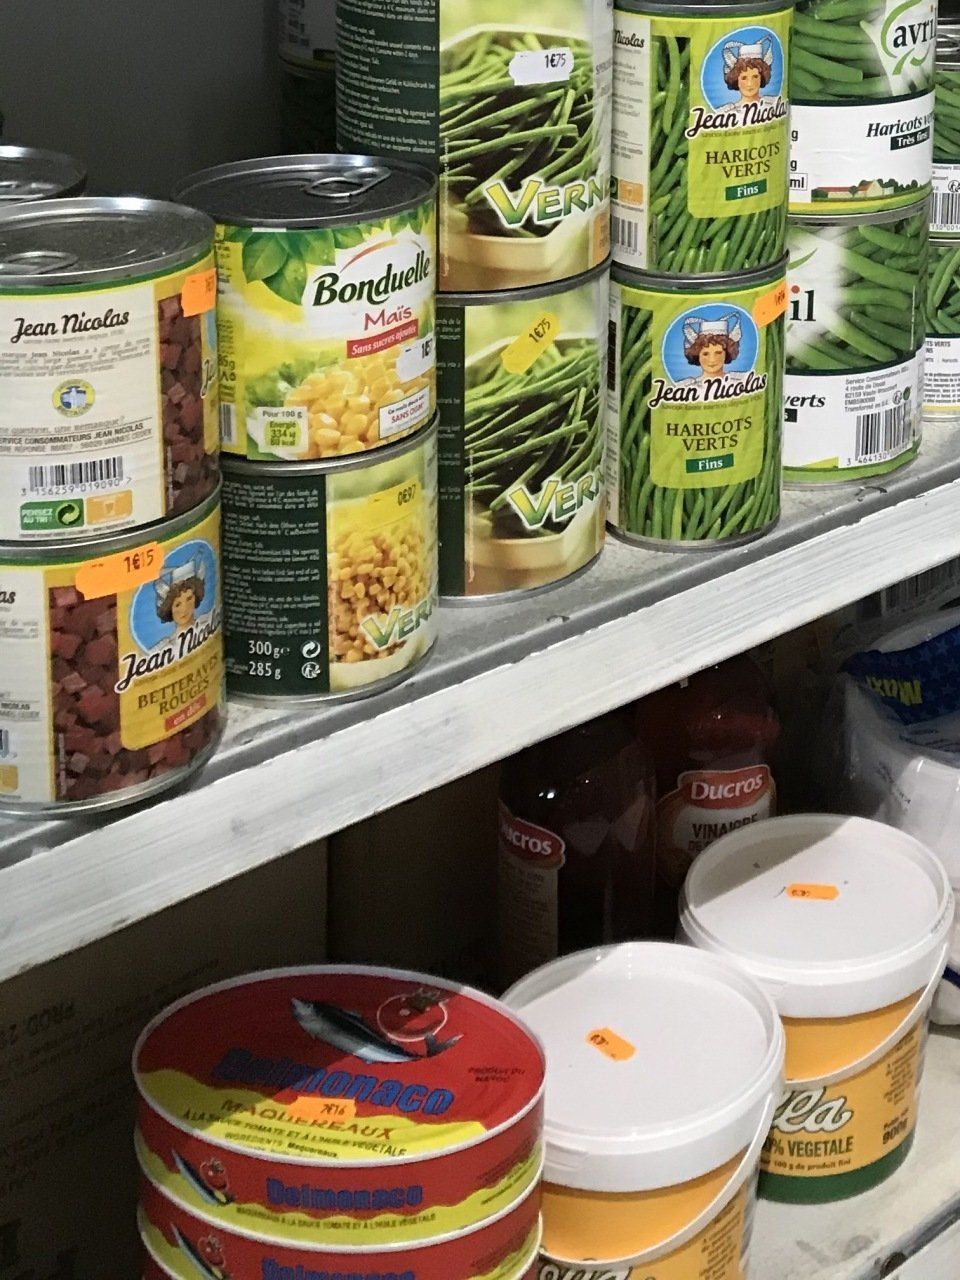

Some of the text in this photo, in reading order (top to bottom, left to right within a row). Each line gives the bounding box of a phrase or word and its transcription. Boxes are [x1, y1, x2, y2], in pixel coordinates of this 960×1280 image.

[544, 53, 568, 69] 1€75
[685, 107, 738, 139] Jean
[866, 116, 923, 139] Haricots
[705, 141, 781, 165] HARICOTS
[896, 135, 915, 148] Très
[722, 160, 771, 179] VERTS
[737, 185, 760, 198] Fins
[312, 250, 431, 307] Bonduelle
[10, 308, 131, 344] Jean Nicolas
[363, 304, 413, 331] Maïs
[528, 317, 552, 344] 1€75
[352, 341, 373, 356] Sans
[373, 335, 395, 352] sucres
[649, 370, 768, 408] Jean Nicolas
[390, 411, 410, 424] SANS
[665, 416, 753, 438] HARICOTS
[24, 422, 144, 446] CONSOMMATEURS JEAN NICOLAS
[270, 429, 287, 438] 334
[681, 433, 739, 453] VERTS
[697, 457, 724, 471] Fins
[123, 548, 155, 573] 1€15
[248, 640, 272, 657] 300
[115, 650, 174, 692] Jean
[248, 662, 272, 677] 285
[138, 655, 220, 710] BETTERAVES
[158, 677, 210, 716] ROUGES
[690, 774, 763, 802] Ducros
[786, 1136, 855, 1159] VEGETALE
